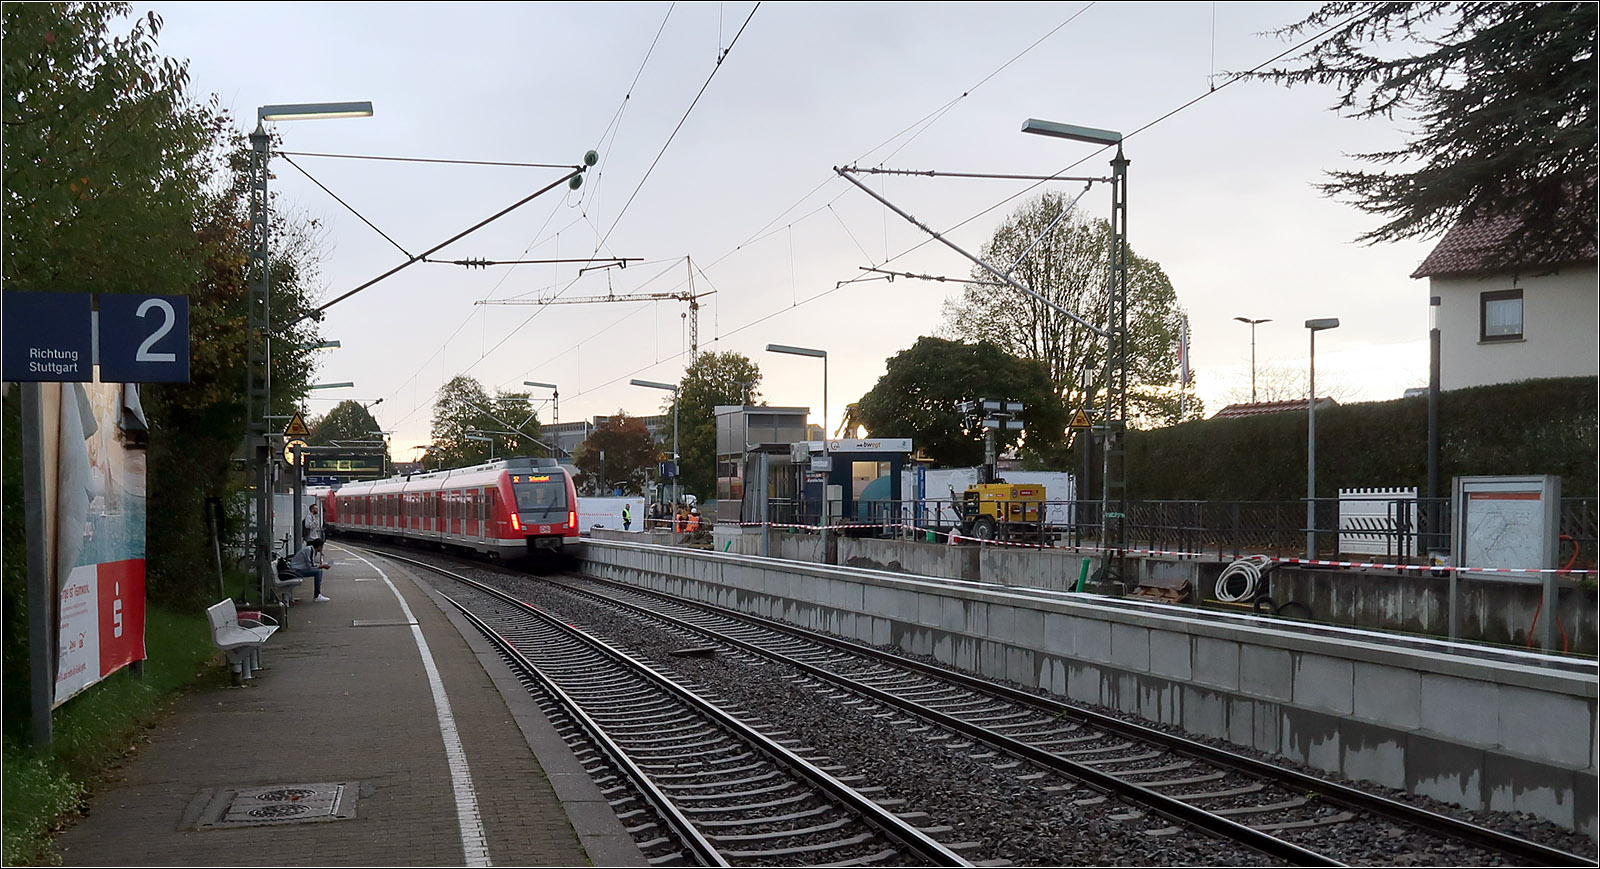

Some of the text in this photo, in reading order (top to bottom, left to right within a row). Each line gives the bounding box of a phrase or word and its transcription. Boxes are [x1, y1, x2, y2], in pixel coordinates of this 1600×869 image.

[135, 298, 176, 362] 2
[29, 348, 79, 361] Richtung
[29, 362, 79, 374] Stuttgart
